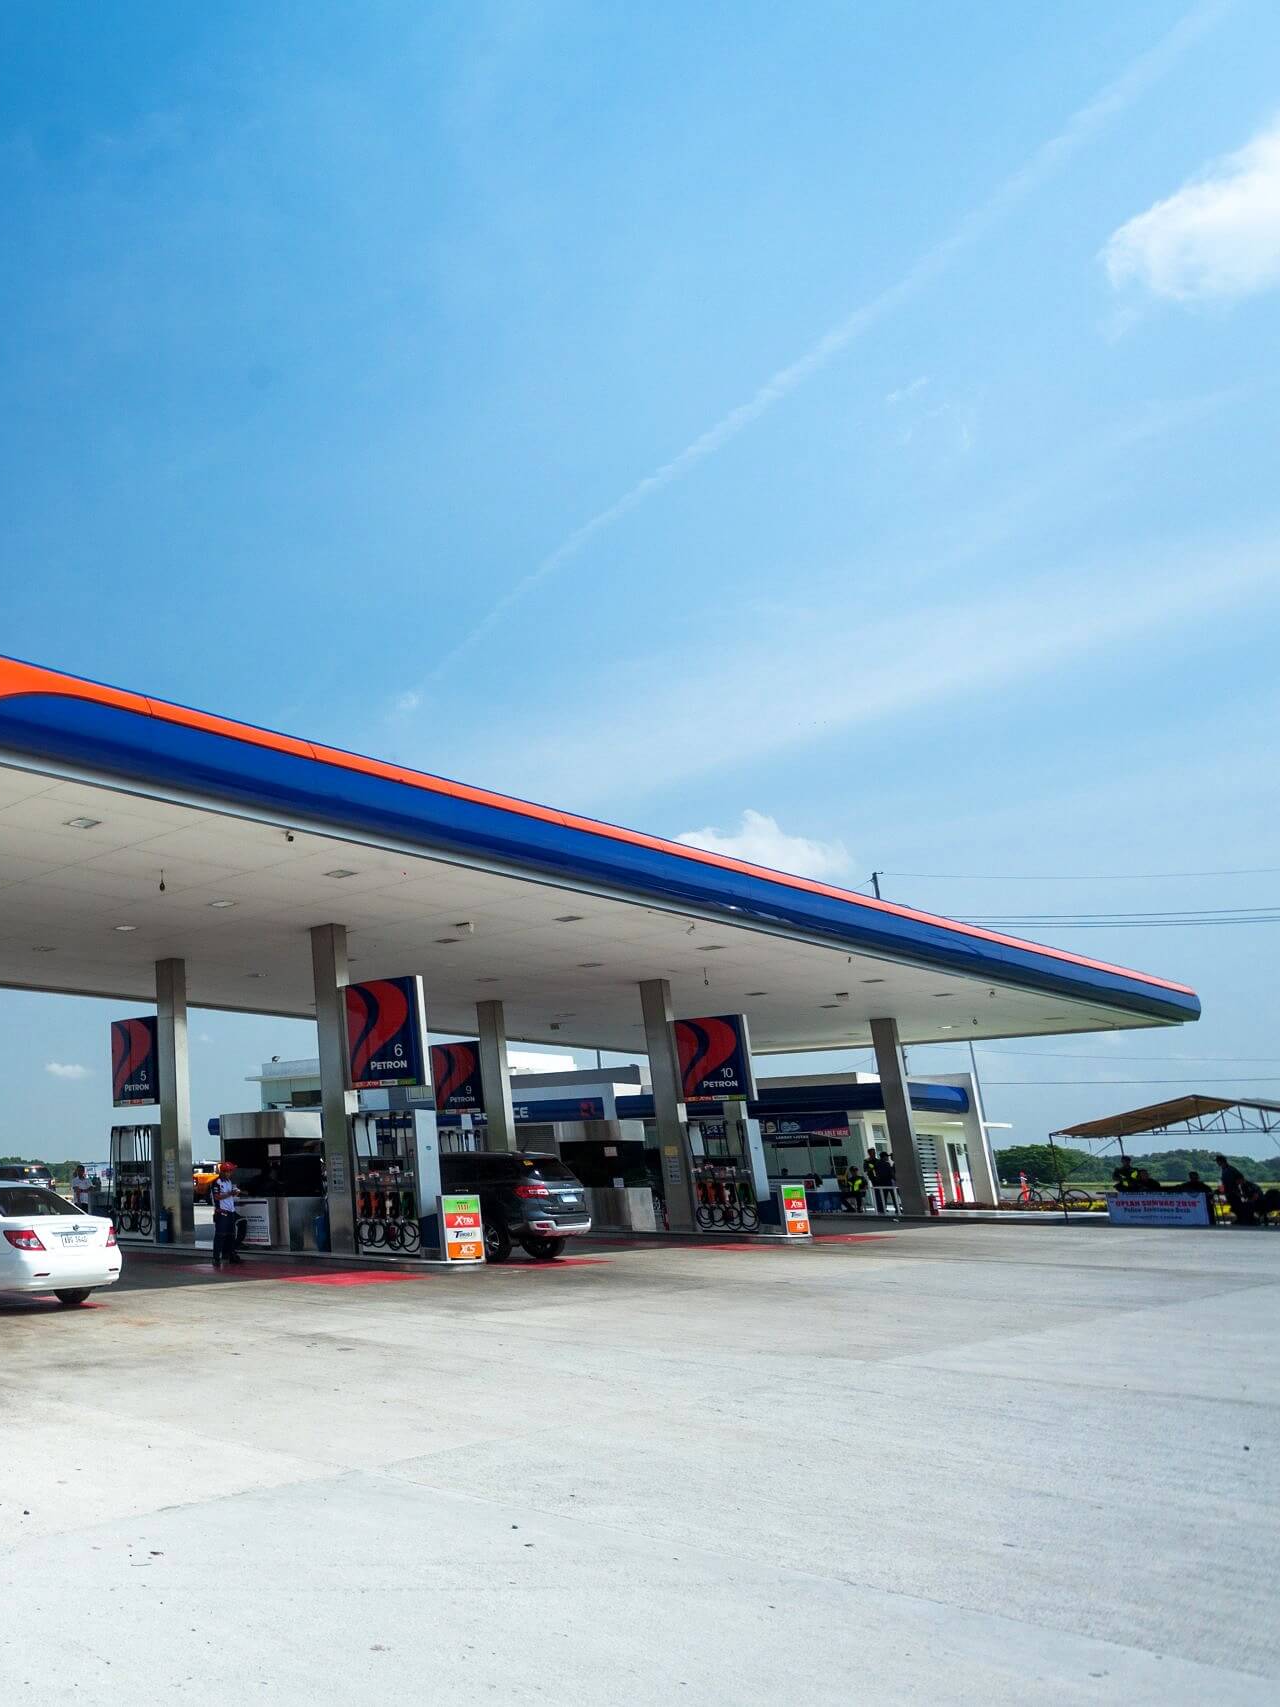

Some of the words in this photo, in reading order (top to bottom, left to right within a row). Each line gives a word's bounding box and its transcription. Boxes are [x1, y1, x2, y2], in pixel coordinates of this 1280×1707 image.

[394, 1043, 404, 1057] 6
[370, 1060, 408, 1071] PETRON
[140, 1070, 148, 1081] 5
[721, 1067, 734, 1078] 10
[124, 1084, 150, 1092] PETRON
[702, 1080, 739, 1088] PETRON
[465, 1085, 472, 1095] 9
[454, 1215, 475, 1226] XTRA
[460, 1244, 477, 1254] XCS
